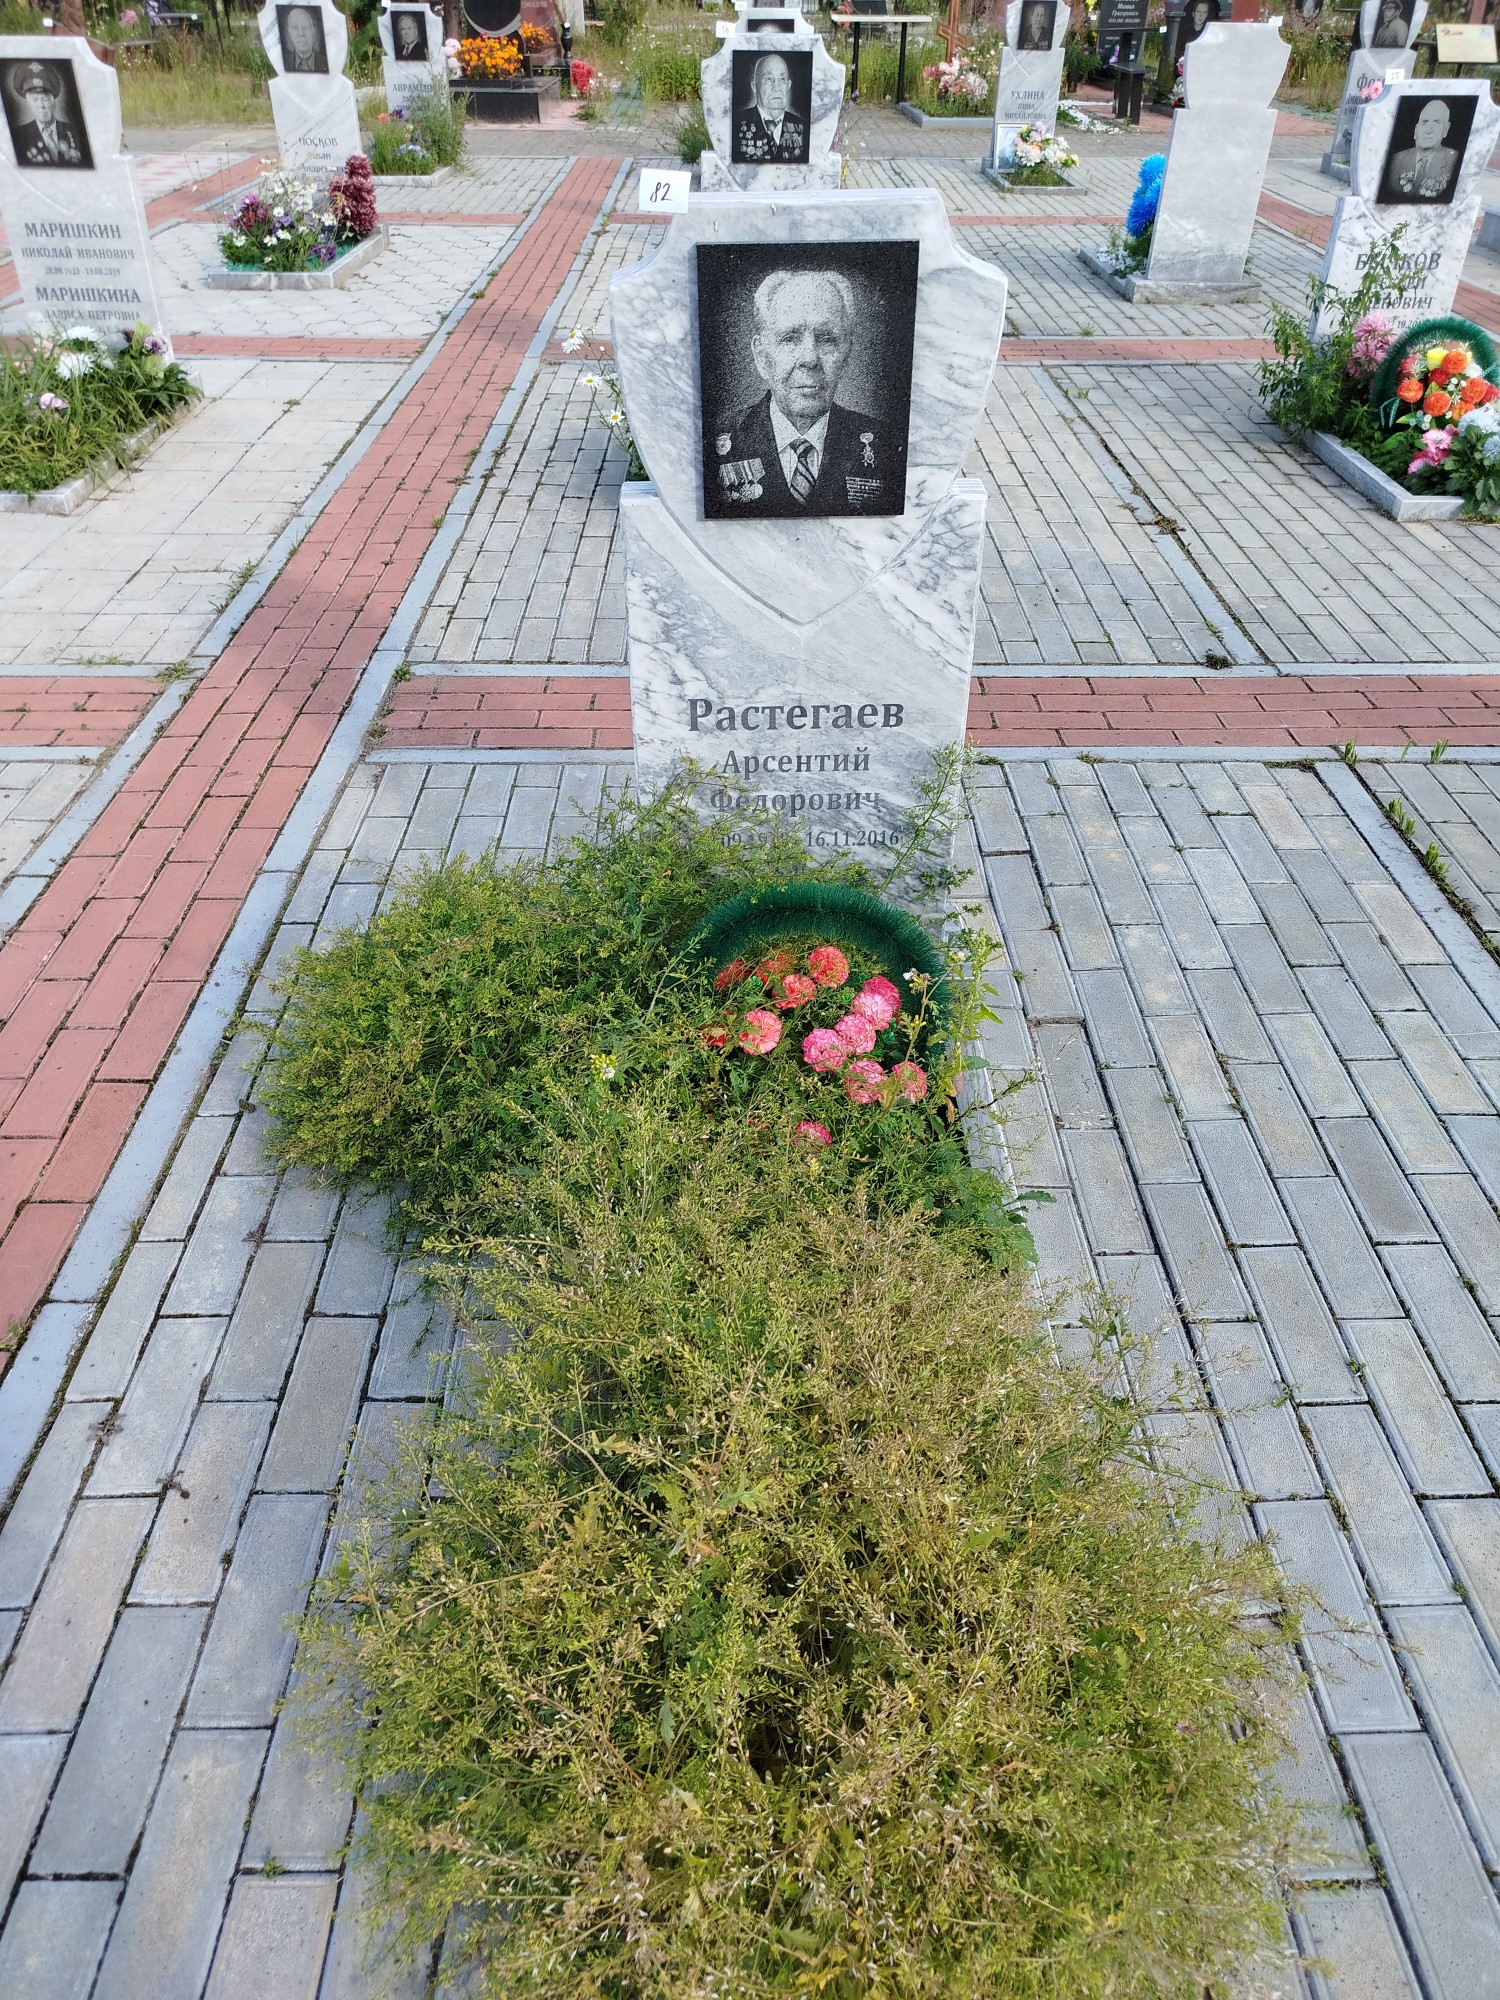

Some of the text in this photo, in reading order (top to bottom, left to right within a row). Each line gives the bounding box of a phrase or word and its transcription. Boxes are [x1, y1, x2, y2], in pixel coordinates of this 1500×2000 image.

[1011, 91, 1045, 100] УХЛИНА
[649, 181, 673, 203] 82
[24, 222, 122, 239] МАРИШКИН
[21, 245, 135, 260] НИКОЛАЙ ИВАНОВИЧ
[35, 286, 142, 303] МАРИШКИНА
[88, 309, 141, 321] ПЕТРОВНА
[688, 698, 905, 732] Растегаев
[721, 746, 870, 780] Арсентий
[710, 787, 881, 818] Федорович
[805, 829, 900, 848] 16.11.2016
